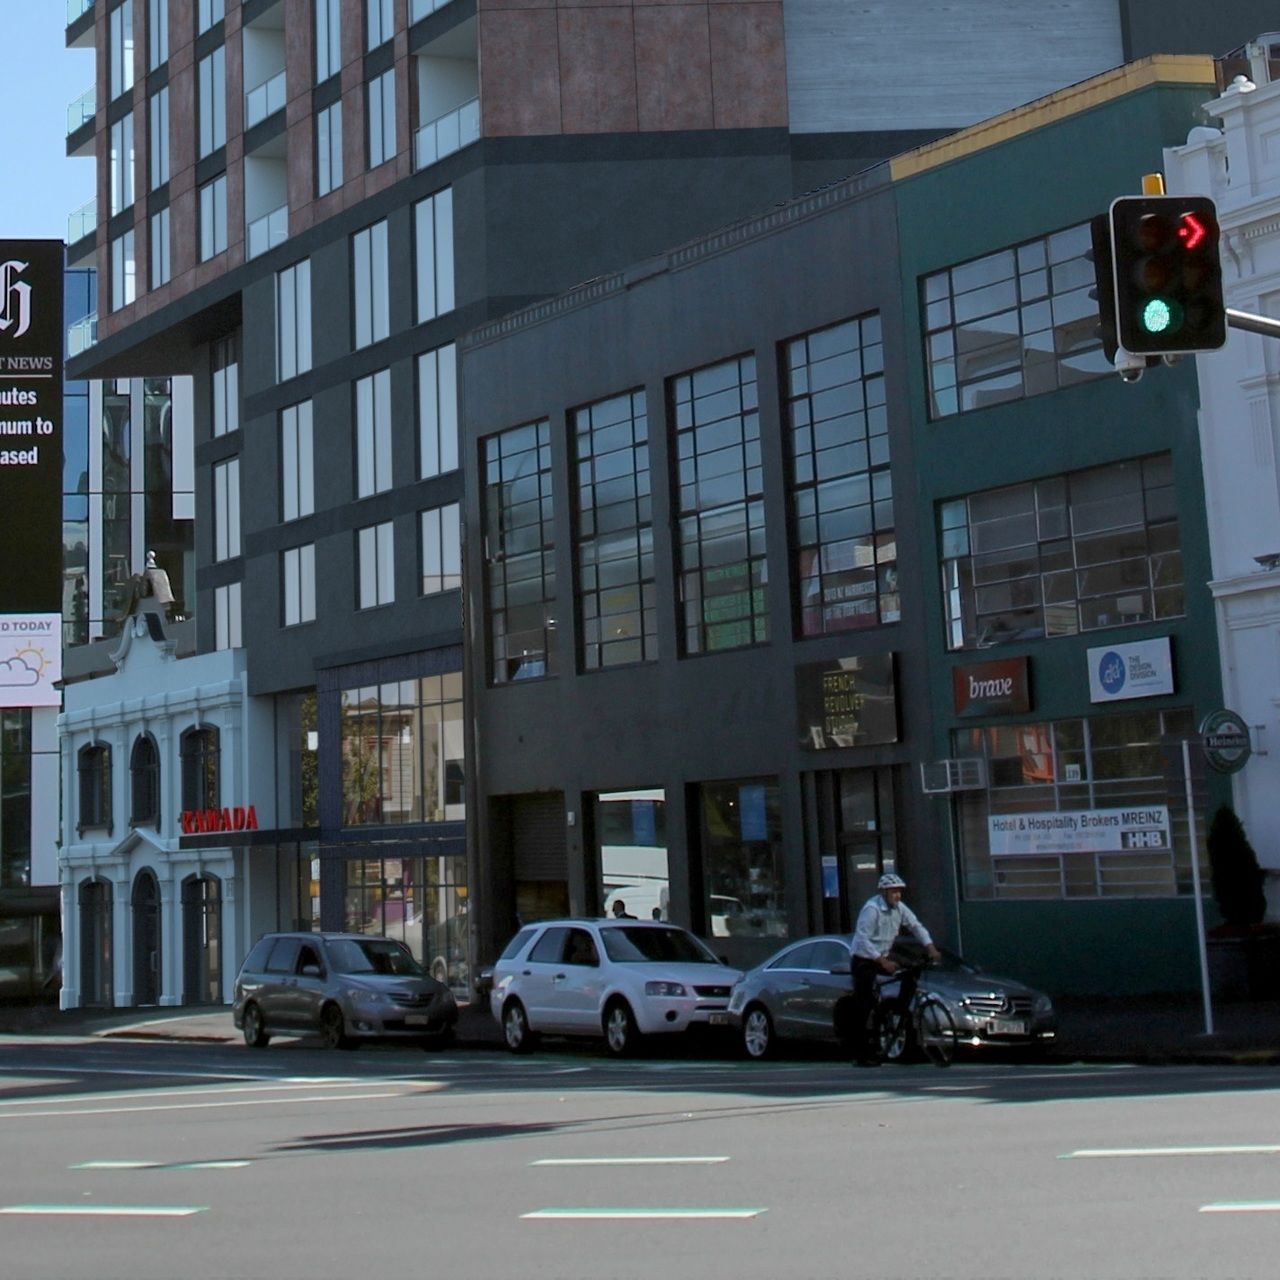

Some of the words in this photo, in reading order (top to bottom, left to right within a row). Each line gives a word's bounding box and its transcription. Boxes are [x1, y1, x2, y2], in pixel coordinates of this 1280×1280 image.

[7, 356, 53, 370] NEWS
[36, 416, 53, 435] to
[11, 621, 53, 631] TODAY
[1128, 655, 1141, 663] THE
[1129, 662, 1152, 673] DESIGN
[1130, 670, 1157, 680] DIVISION
[969, 676, 1013, 699] brave
[182, 804, 259, 835] RAMADA
[992, 819, 1017, 832] Hotel
[1019, 820, 1026, 831] &
[1028, 816, 1078, 833] Hospitality
[1081, 814, 1120, 828] Brokers
[1121, 810, 1163, 826] MREINZ
[1126, 831, 1162, 848] HHB
